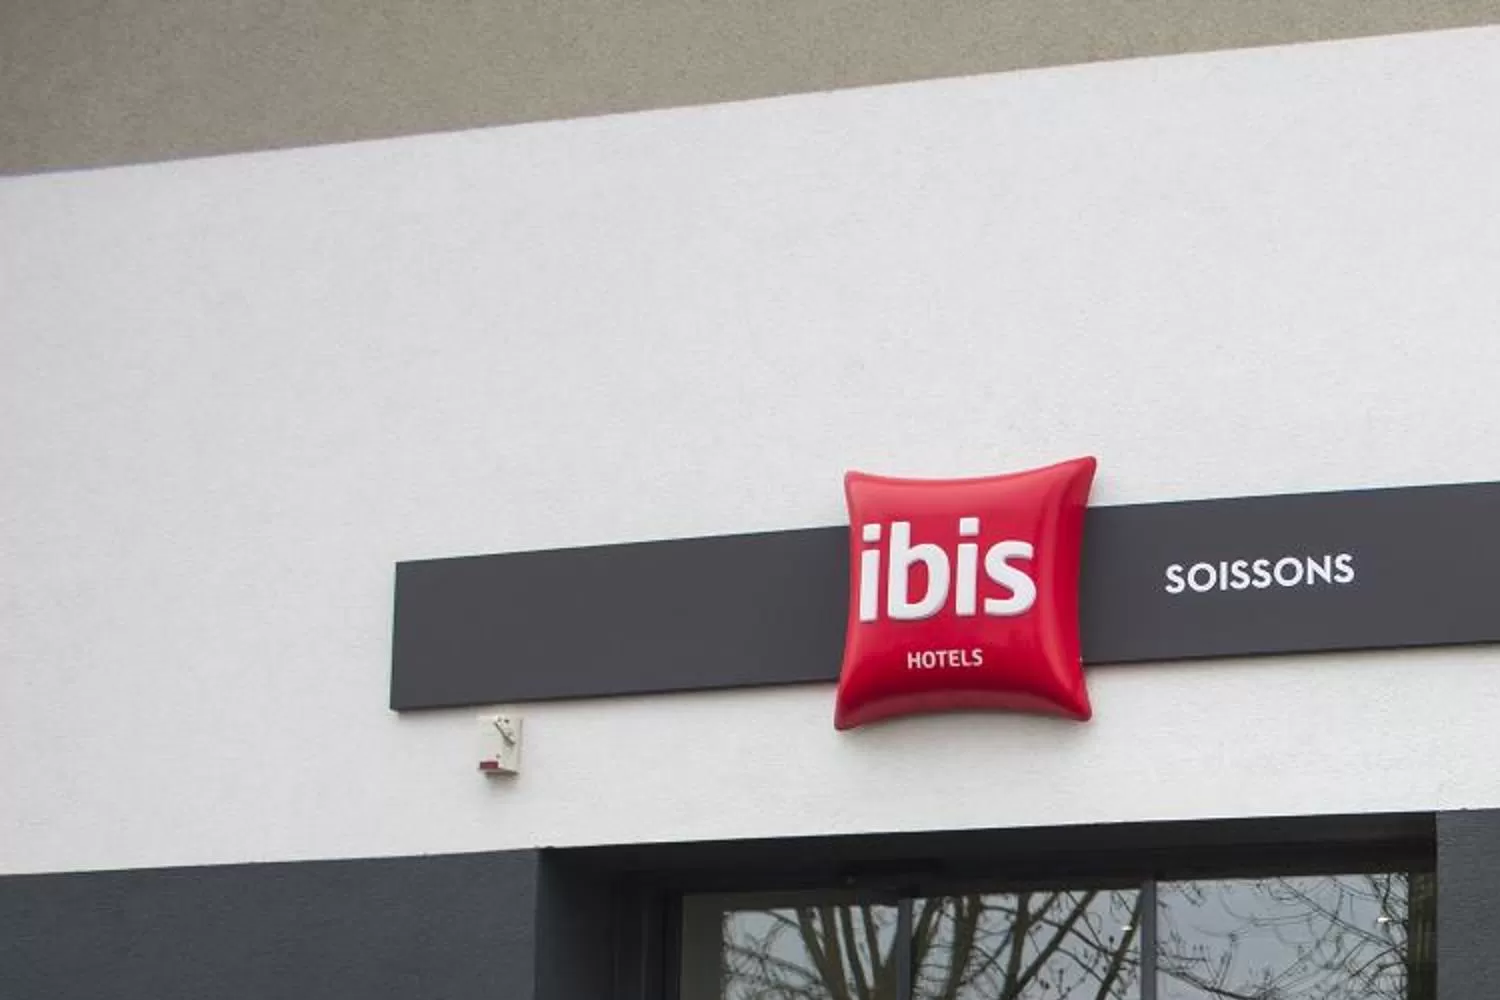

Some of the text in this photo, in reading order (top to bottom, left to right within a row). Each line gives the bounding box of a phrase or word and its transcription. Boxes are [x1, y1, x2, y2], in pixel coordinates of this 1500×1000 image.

[858, 516, 1037, 624] ibis
[1164, 553, 1356, 595] SOISSONS
[906, 648, 983, 670] HOTELS
